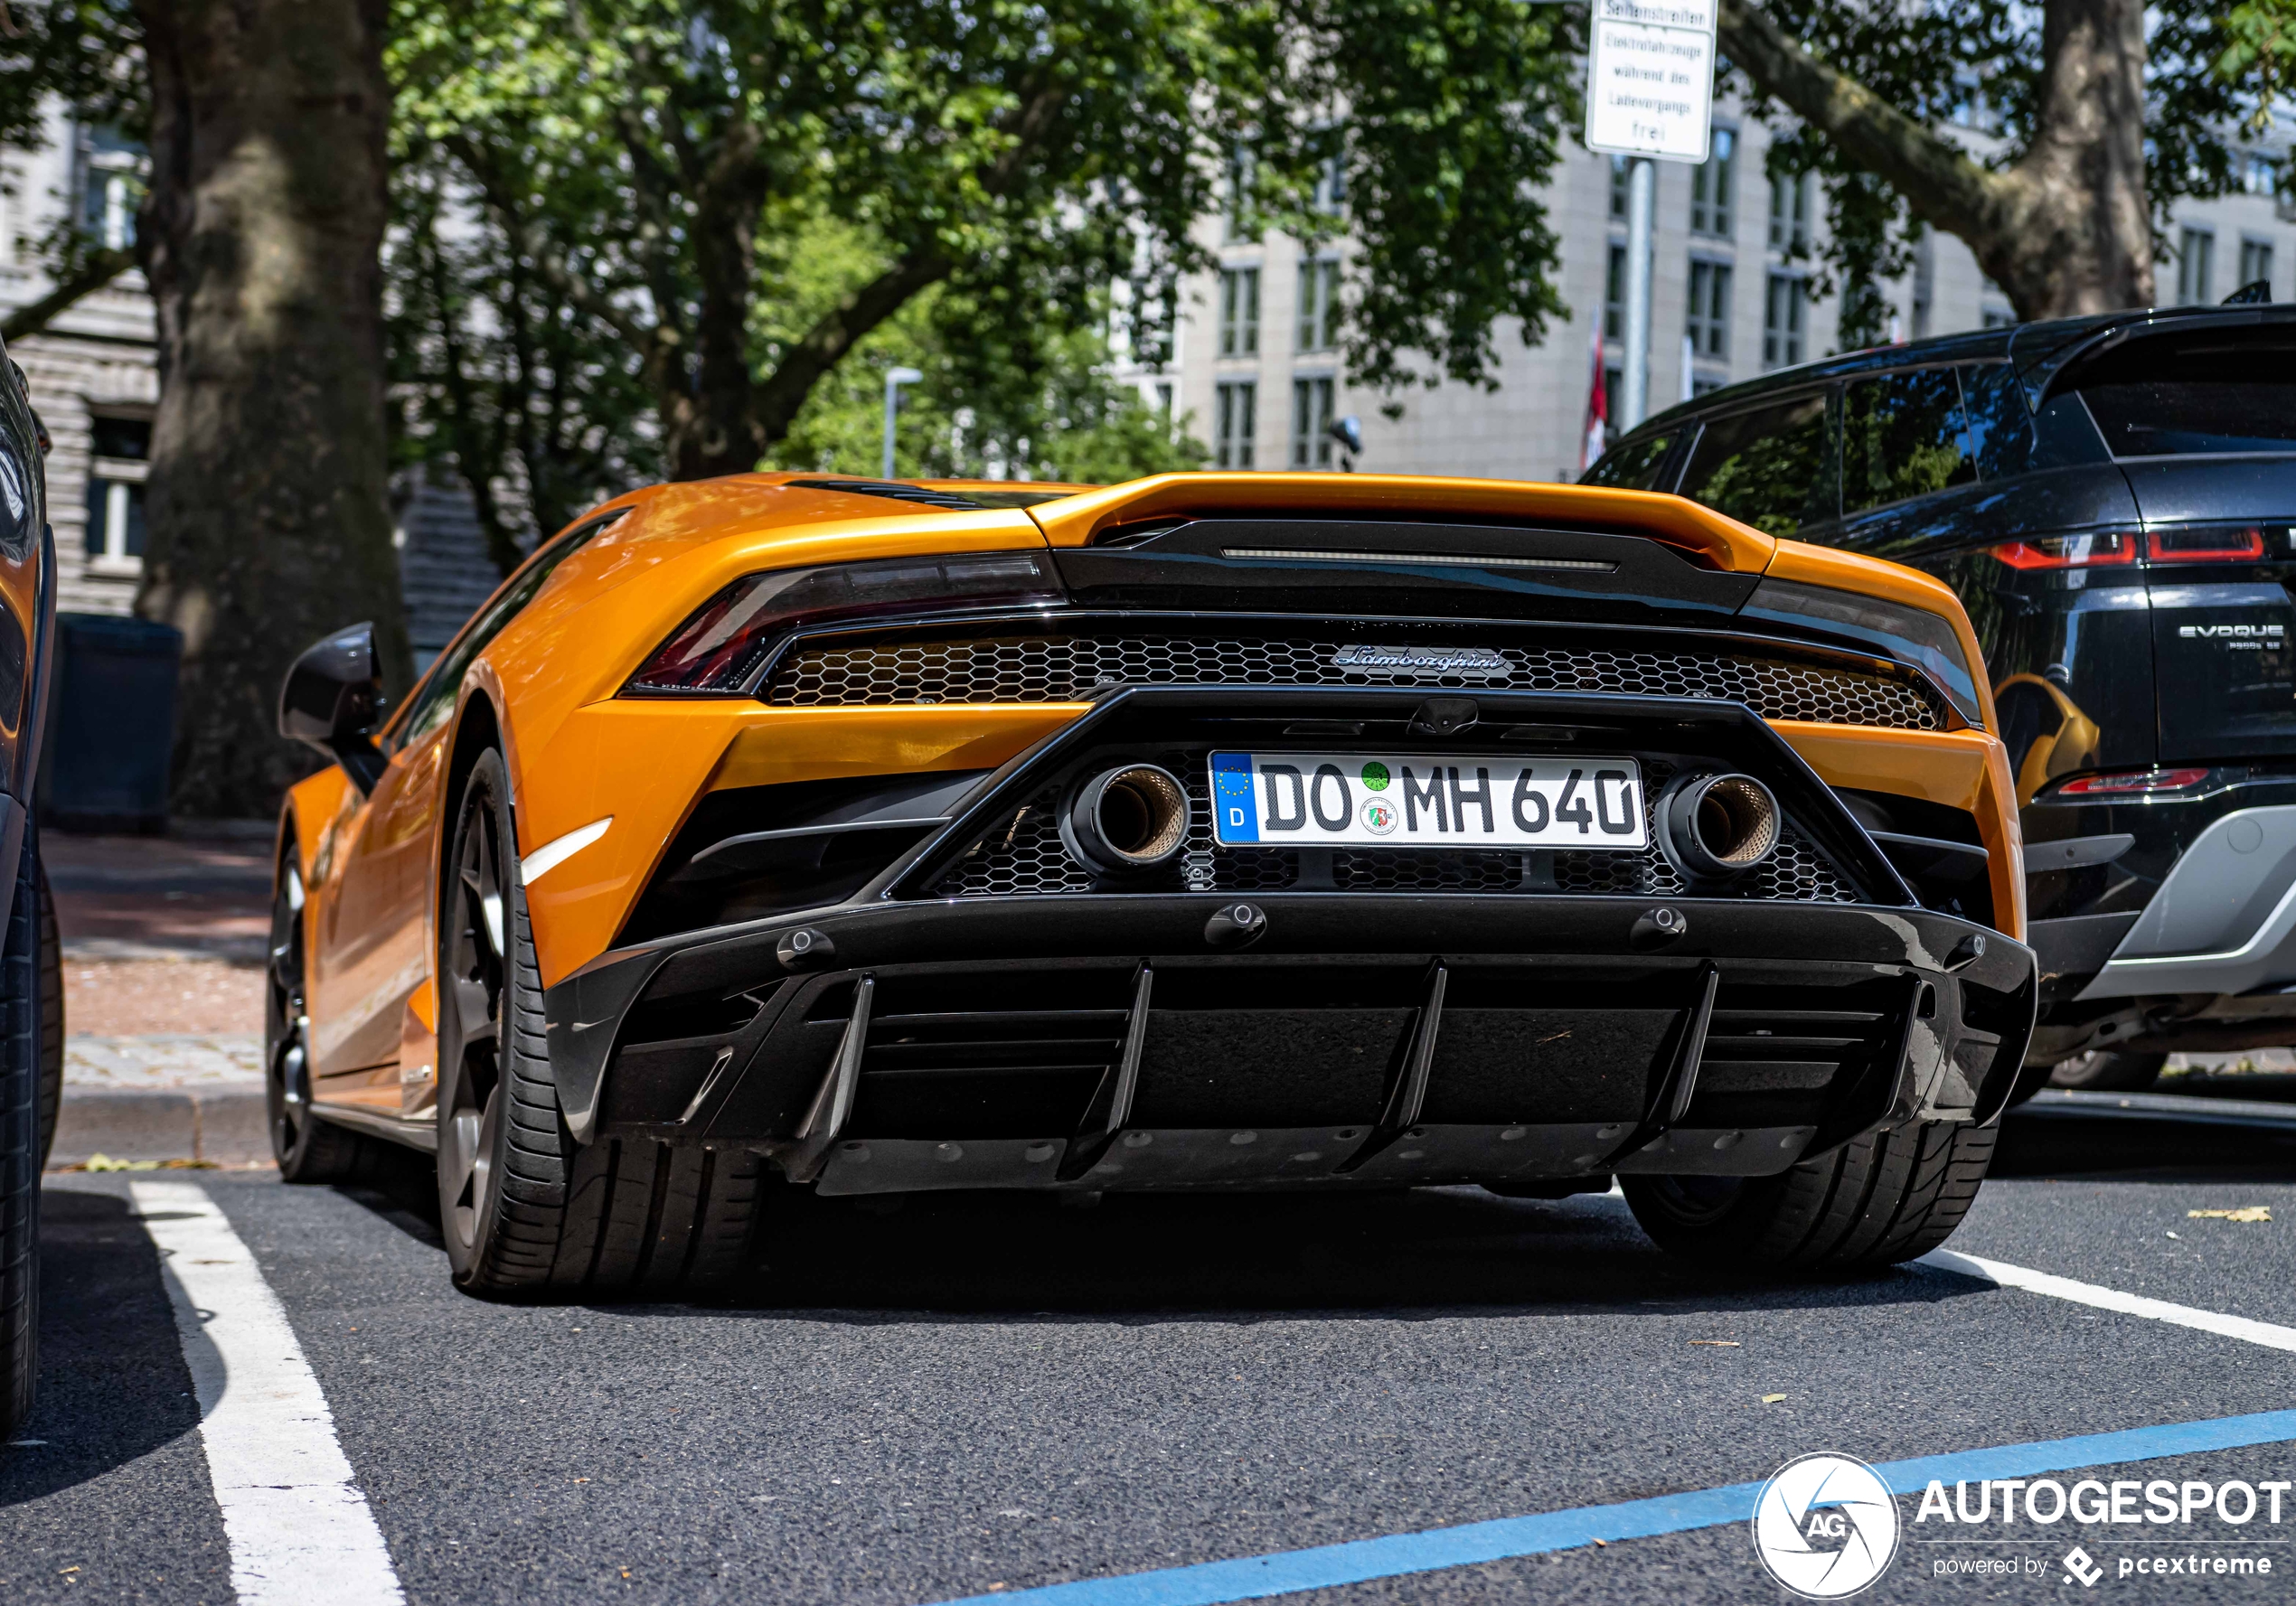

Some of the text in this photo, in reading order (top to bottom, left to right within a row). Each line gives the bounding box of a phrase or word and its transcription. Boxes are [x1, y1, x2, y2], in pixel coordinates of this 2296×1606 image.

[1605, 0, 1705, 24] Seitenstreifen
[1614, 66, 1690, 85] während des
[1609, 91, 1691, 116] Ladevorgangs
[1632, 121, 1665, 140] frei
[2179, 625, 2284, 638] EVOQUE
[1335, 645, 1503, 672] Lamborghini
[1259, 764, 1353, 831] DO
[1401, 765, 1494, 833] MH
[1511, 768, 1637, 835] 640
[1229, 808, 1245, 827] D
